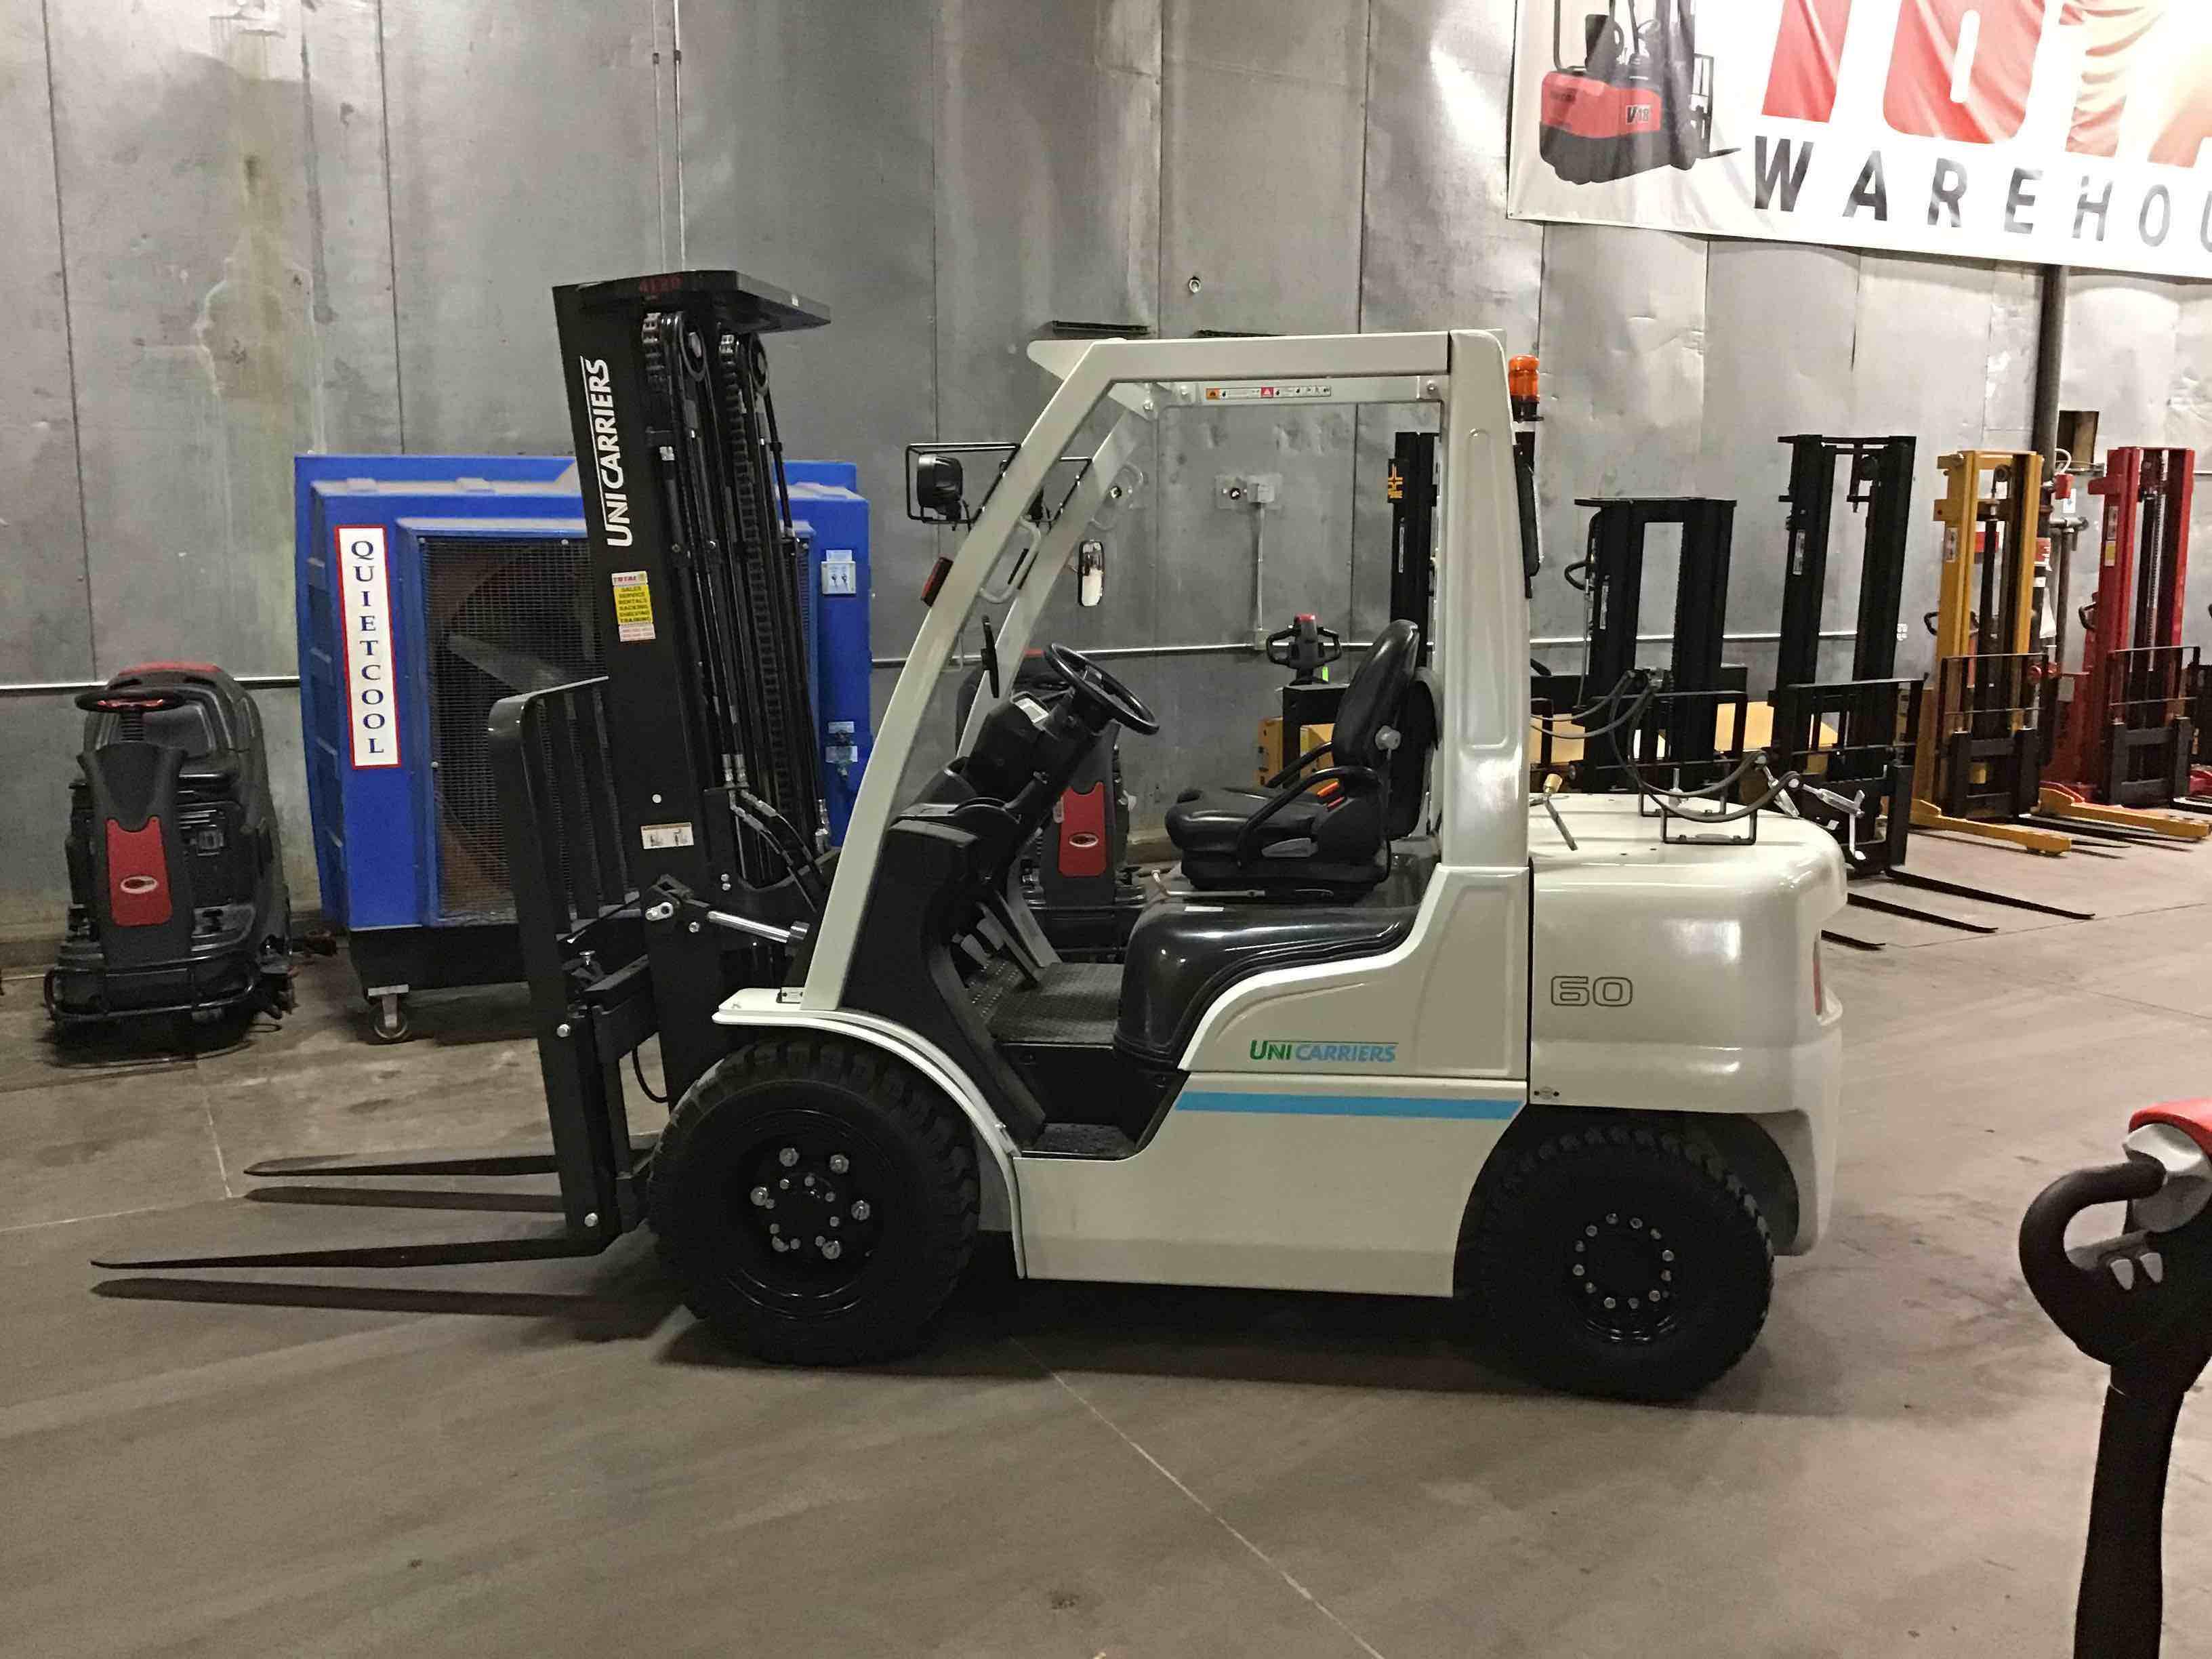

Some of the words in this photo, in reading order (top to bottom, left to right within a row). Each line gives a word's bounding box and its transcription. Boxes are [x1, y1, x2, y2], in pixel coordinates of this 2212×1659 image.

[1754, 135, 2212, 253] WAREHO
[350, 540, 384, 754] QUIETCOOL
[1551, 976, 1633, 1007] 60
